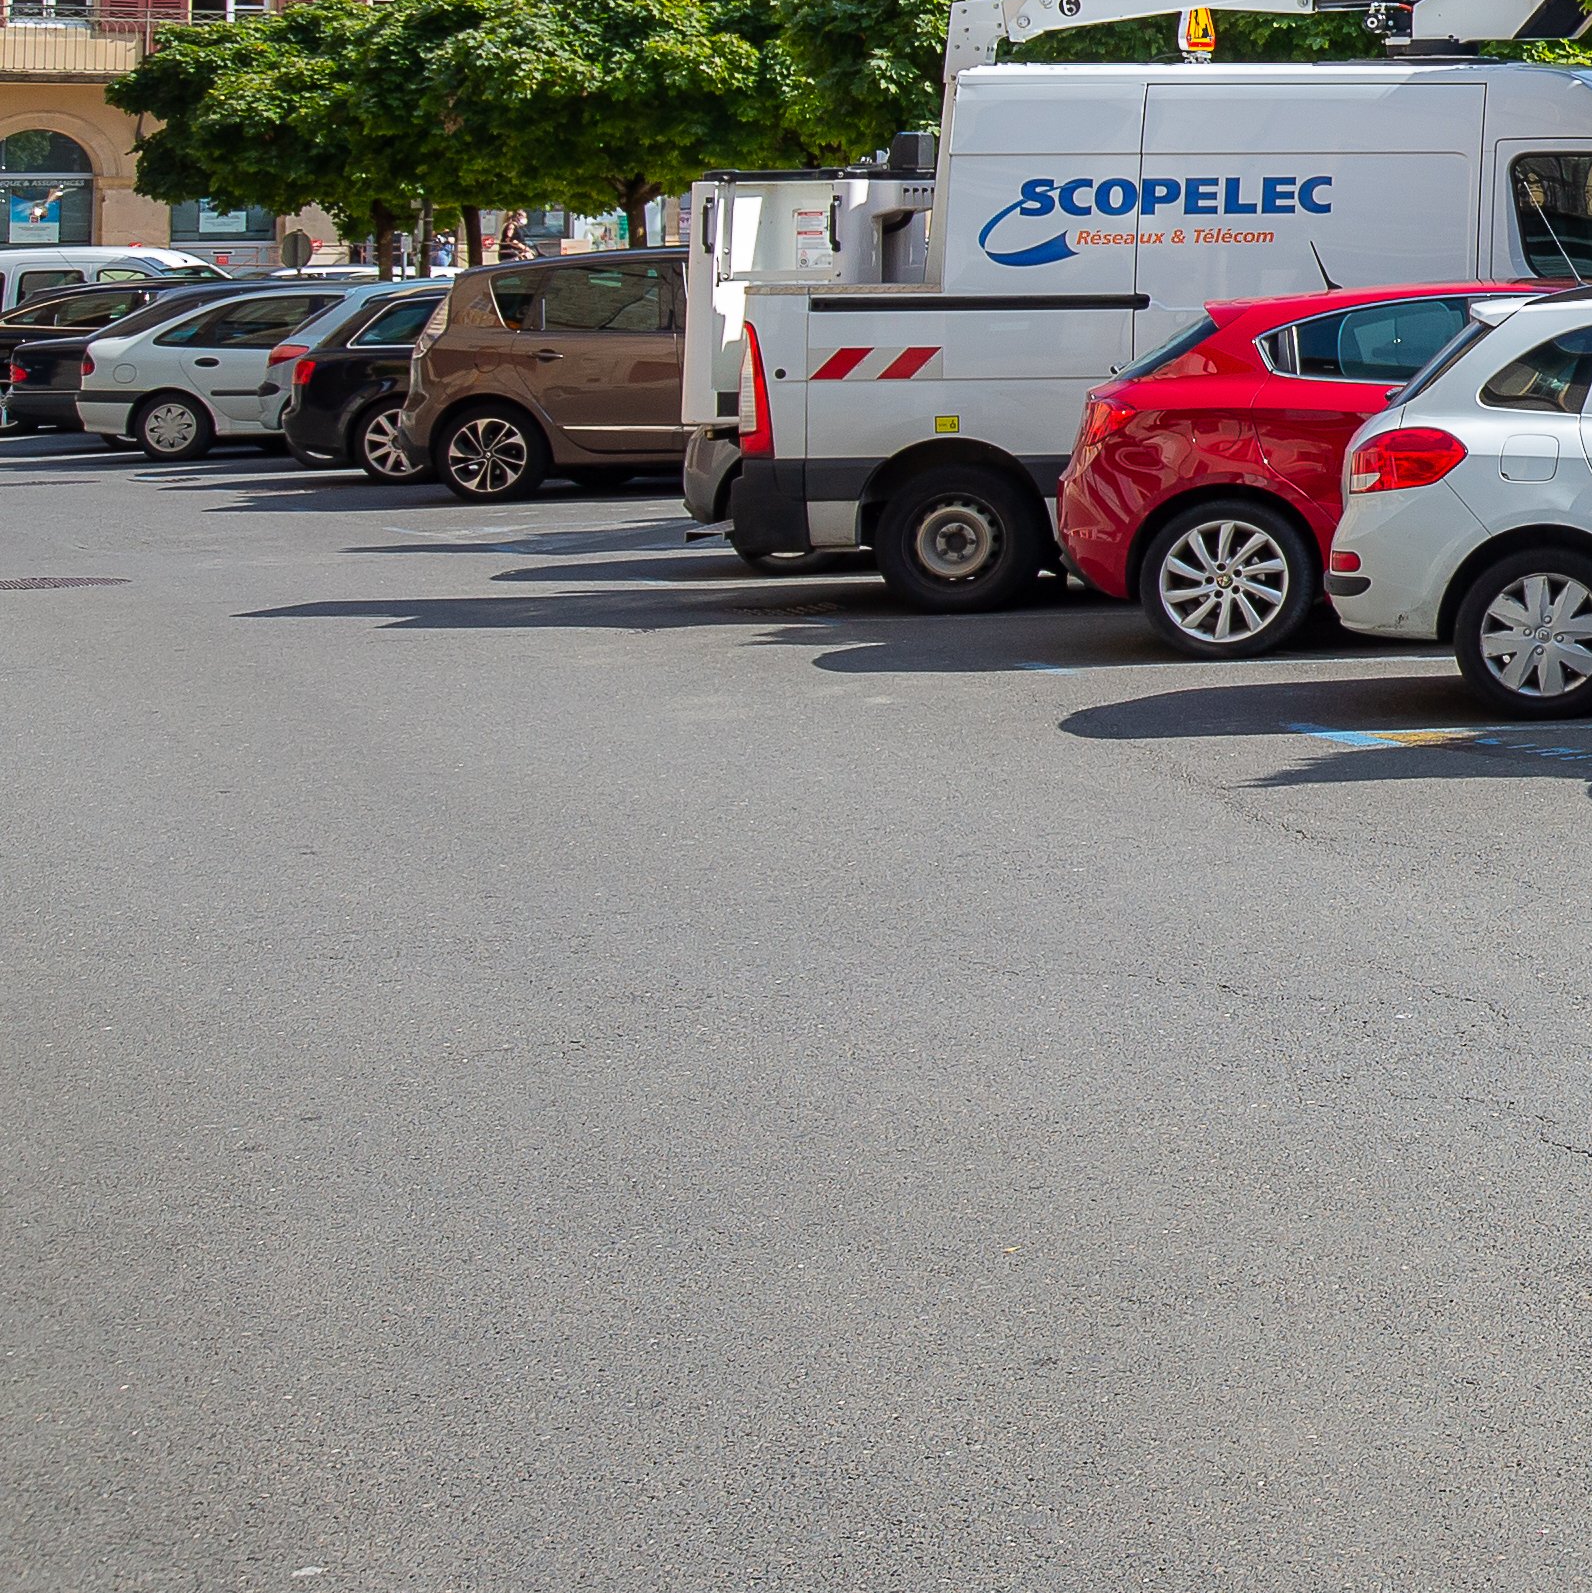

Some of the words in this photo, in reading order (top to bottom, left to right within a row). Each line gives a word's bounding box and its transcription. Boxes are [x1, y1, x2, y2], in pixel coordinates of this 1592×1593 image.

[1019, 176, 1333, 216] SCOPELEC
[1076, 229, 1165, 246] Réseaux
[1171, 229, 1186, 244] &
[1193, 228, 1274, 245] Télécom
